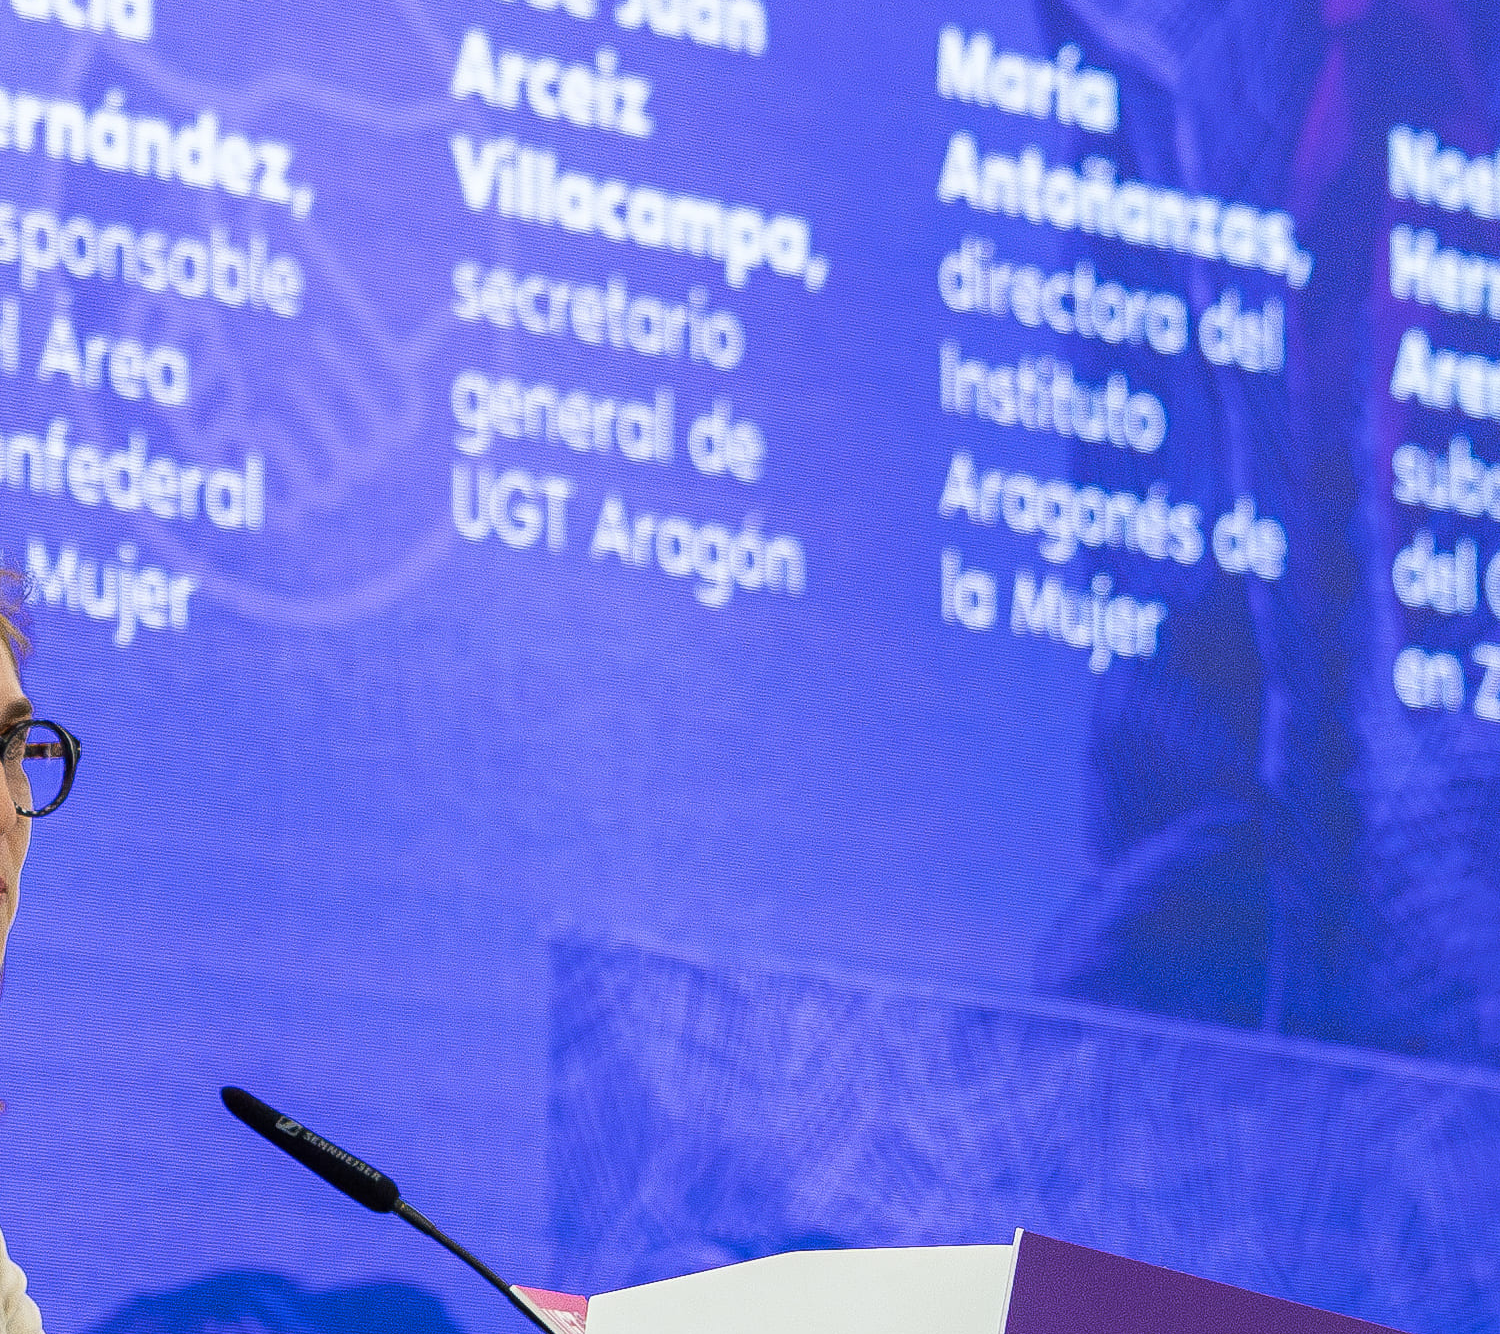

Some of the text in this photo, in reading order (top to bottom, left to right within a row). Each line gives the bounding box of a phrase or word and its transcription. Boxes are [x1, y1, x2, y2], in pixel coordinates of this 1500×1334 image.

[452, 29, 655, 138] Arceiz
[937, 25, 1119, 135] María
[451, 134, 829, 291] Villacampa,
[937, 132, 1314, 289] Antoñanzas,
[40, 294, 189, 407] Área
[452, 262, 745, 369] secretario
[938, 234, 1285, 374] directora del
[452, 369, 766, 483] general de
[939, 341, 1167, 454] Instituto
[452, 467, 806, 608] UGT Aragón
[938, 452, 1289, 580] Aragonés de
[1392, 530, 1478, 615] del
[26, 539, 198, 648] Mujer
[940, 549, 1168, 673] la Mujer
[1393, 646, 1466, 712] en
[303, 1131, 382, 1182] SENNHEISER
